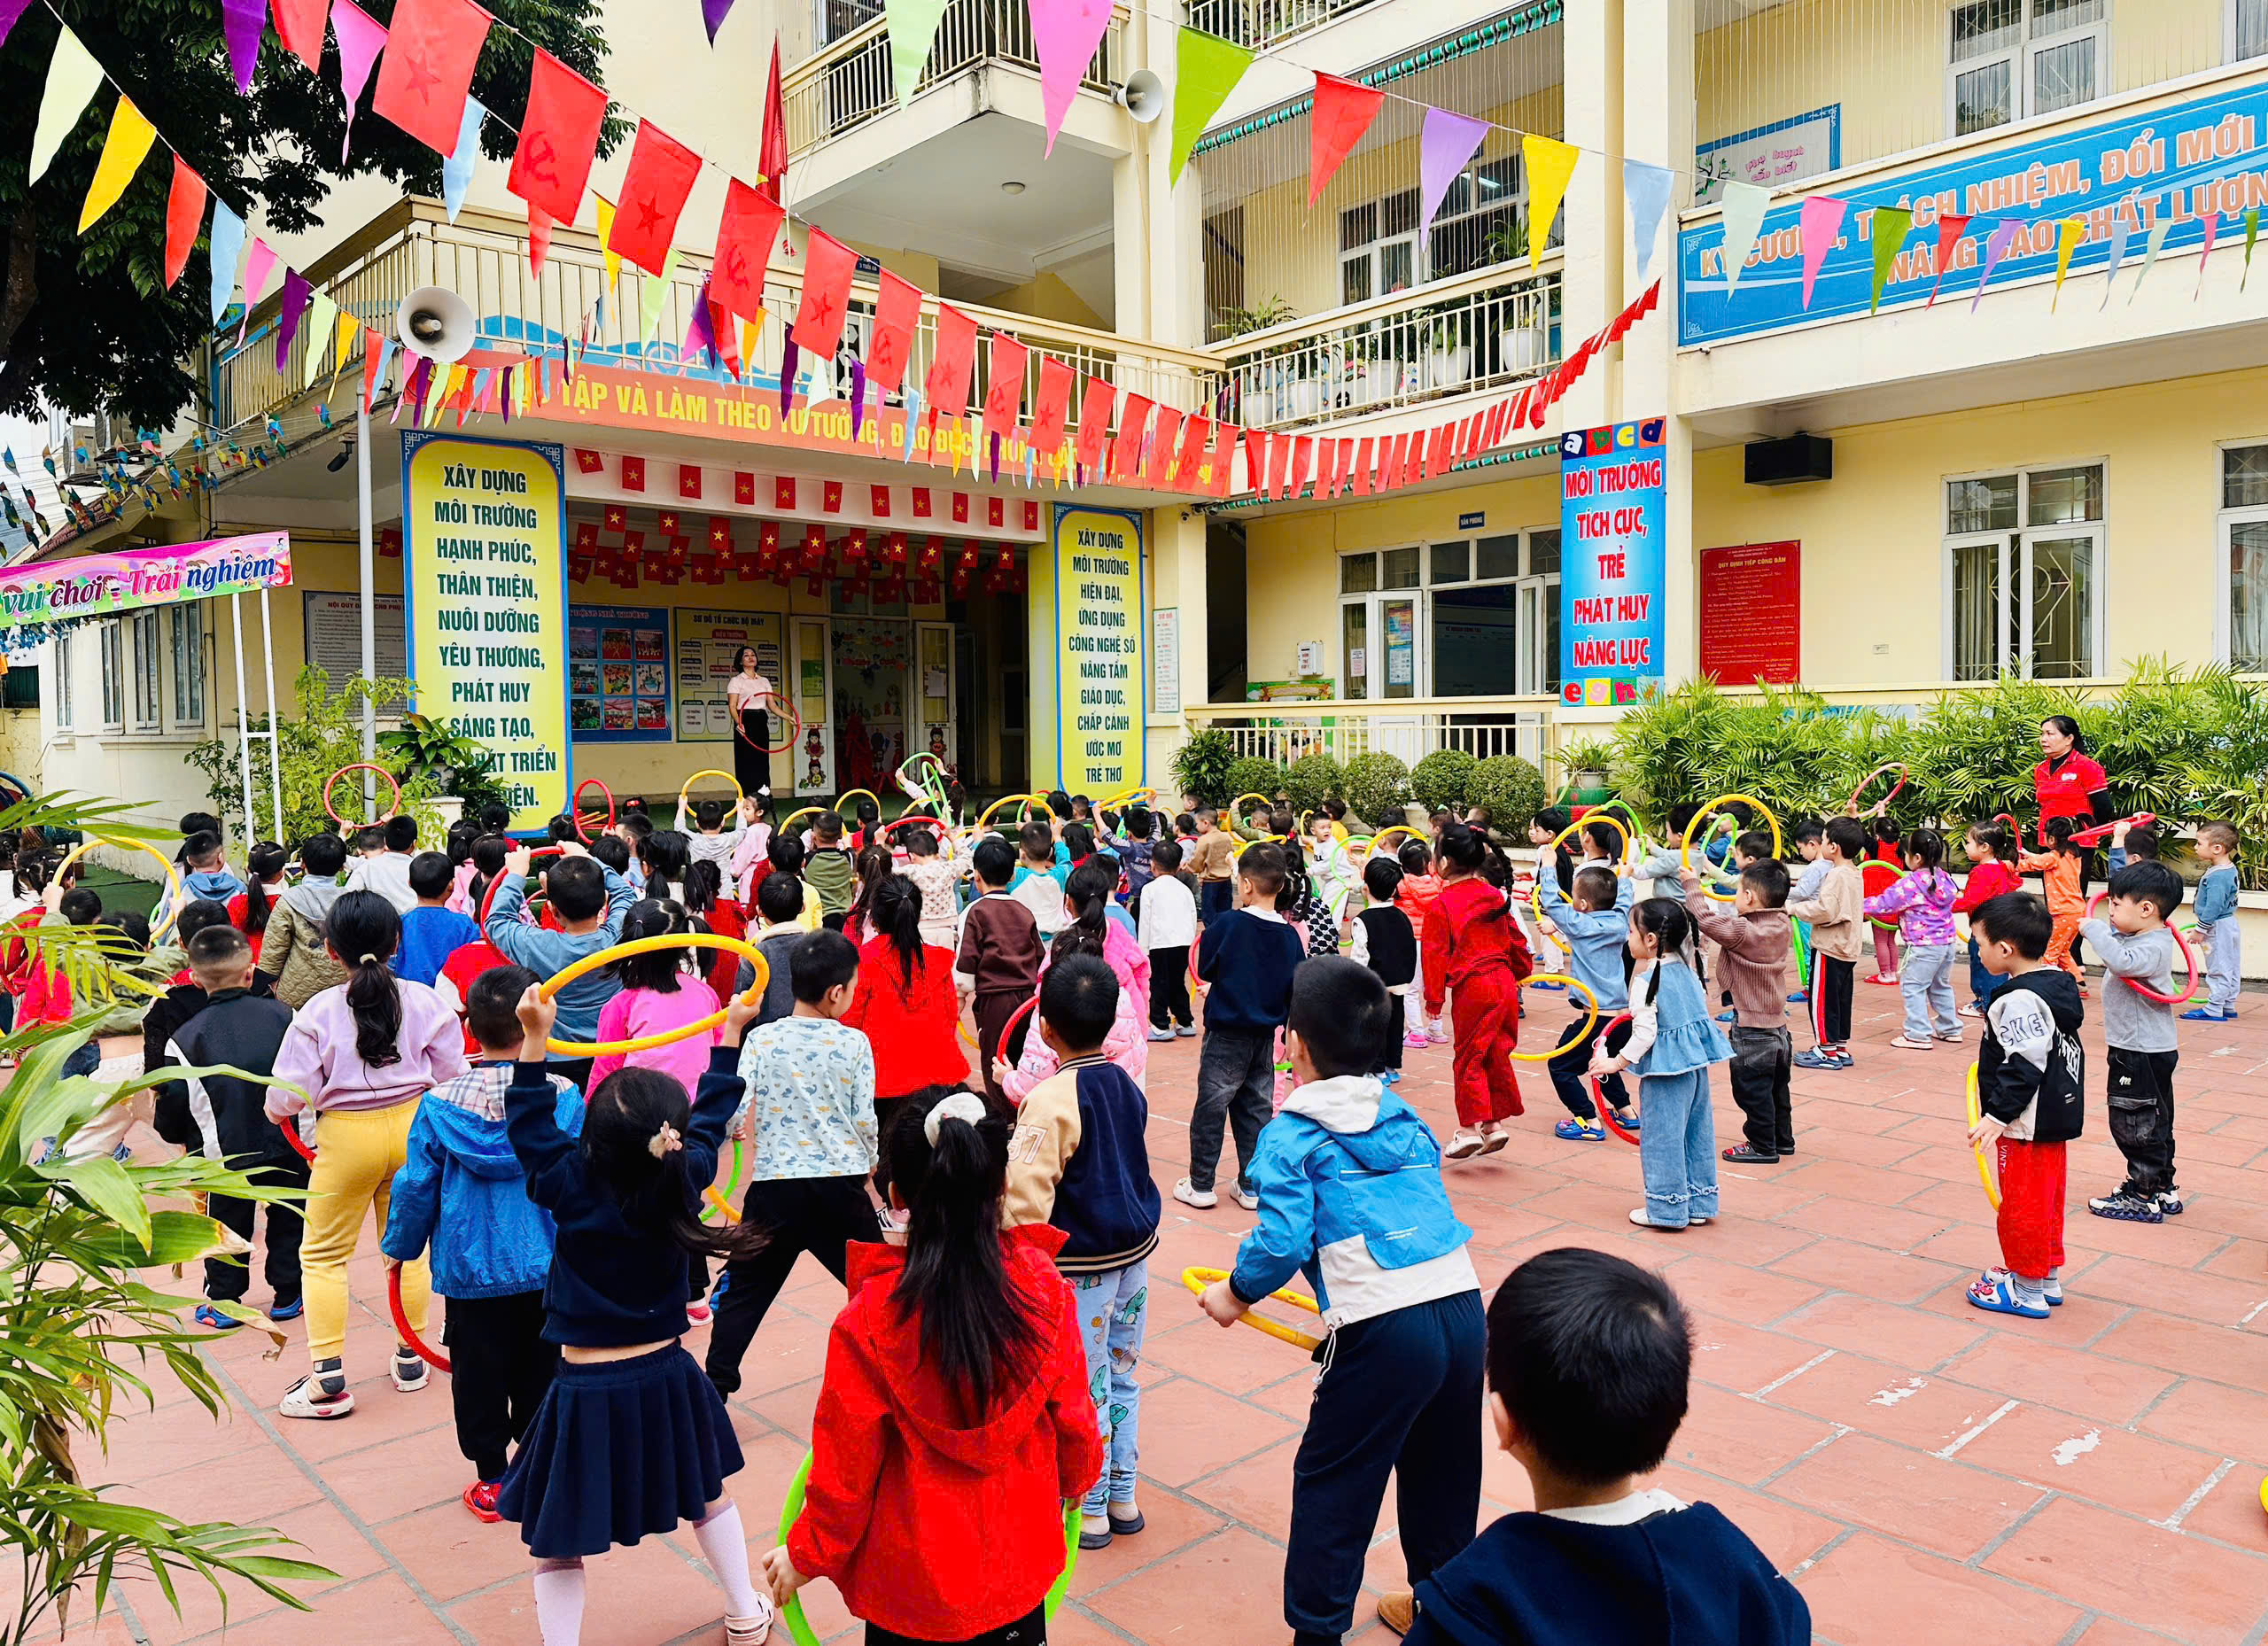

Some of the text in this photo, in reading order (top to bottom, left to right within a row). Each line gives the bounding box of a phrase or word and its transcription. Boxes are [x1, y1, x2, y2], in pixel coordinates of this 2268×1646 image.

[1744, 225, 1847, 268] CƯƠ,
[1854, 189, 1956, 242] TÁCH
[1966, 159, 2091, 215] NHIỆM,
[2100, 128, 2164, 185] ĐỔI
[2177, 113, 2255, 168] MỚI
[561, 374, 608, 415] TẬP
[616, 381, 649, 415] VÀ
[656, 386, 707, 423] LÀM
[714, 399, 771, 431] THEO
[890, 422, 928, 453] ĐO
[444, 462, 526, 495] XÂY DỰNG
[1565, 458, 1662, 499] MÔI TRƯỜNG
[434, 499, 537, 529] MÔI TRƯỜNG
[1576, 506, 1648, 540] TÍCH CỰC,
[437, 538, 537, 566] HẠNH PHÚC,
[1077, 528, 1123, 551] XÂY DỰNG
[1073, 554, 1129, 576] MÔI TRƯỜNG
[1597, 545, 1626, 580] TRẺ
[1, 584, 44, 615] vui
[50, 575, 105, 609] chơi
[128, 561, 182, 598] Trải
[186, 554, 276, 593] nghiệm
[437, 571, 538, 602] THÂN THIỆN,
[1080, 581, 1122, 604] HIỆN ĐẠI,
[439, 607, 540, 633] NUÔI DƯỠNG
[1078, 607, 1125, 630] ỨNG DỤNG
[1573, 594, 1651, 625] PHÁT HUY
[439, 642, 545, 670] YÊU THƯƠNG,
[1068, 633, 1136, 656] CÔNG NGHỆ SỐ
[1573, 636, 1651, 670] NĂNG LỰC
[1080, 660, 1106, 679] NÂNG
[452, 678, 530, 703] PHÁT HUY
[1081, 687, 1126, 708] GIÁO DỤC,
[450, 714, 534, 742] SÁNG TẠO,
[1077, 710, 1130, 731] CHẤP CÁNH
[475, 743, 556, 773] HÁT TRIỂN
[1086, 739, 1122, 757] ƯỚC MƠ
[1085, 763, 1122, 782] TRẺ THƠ
[504, 783, 540, 811] IỆN.
